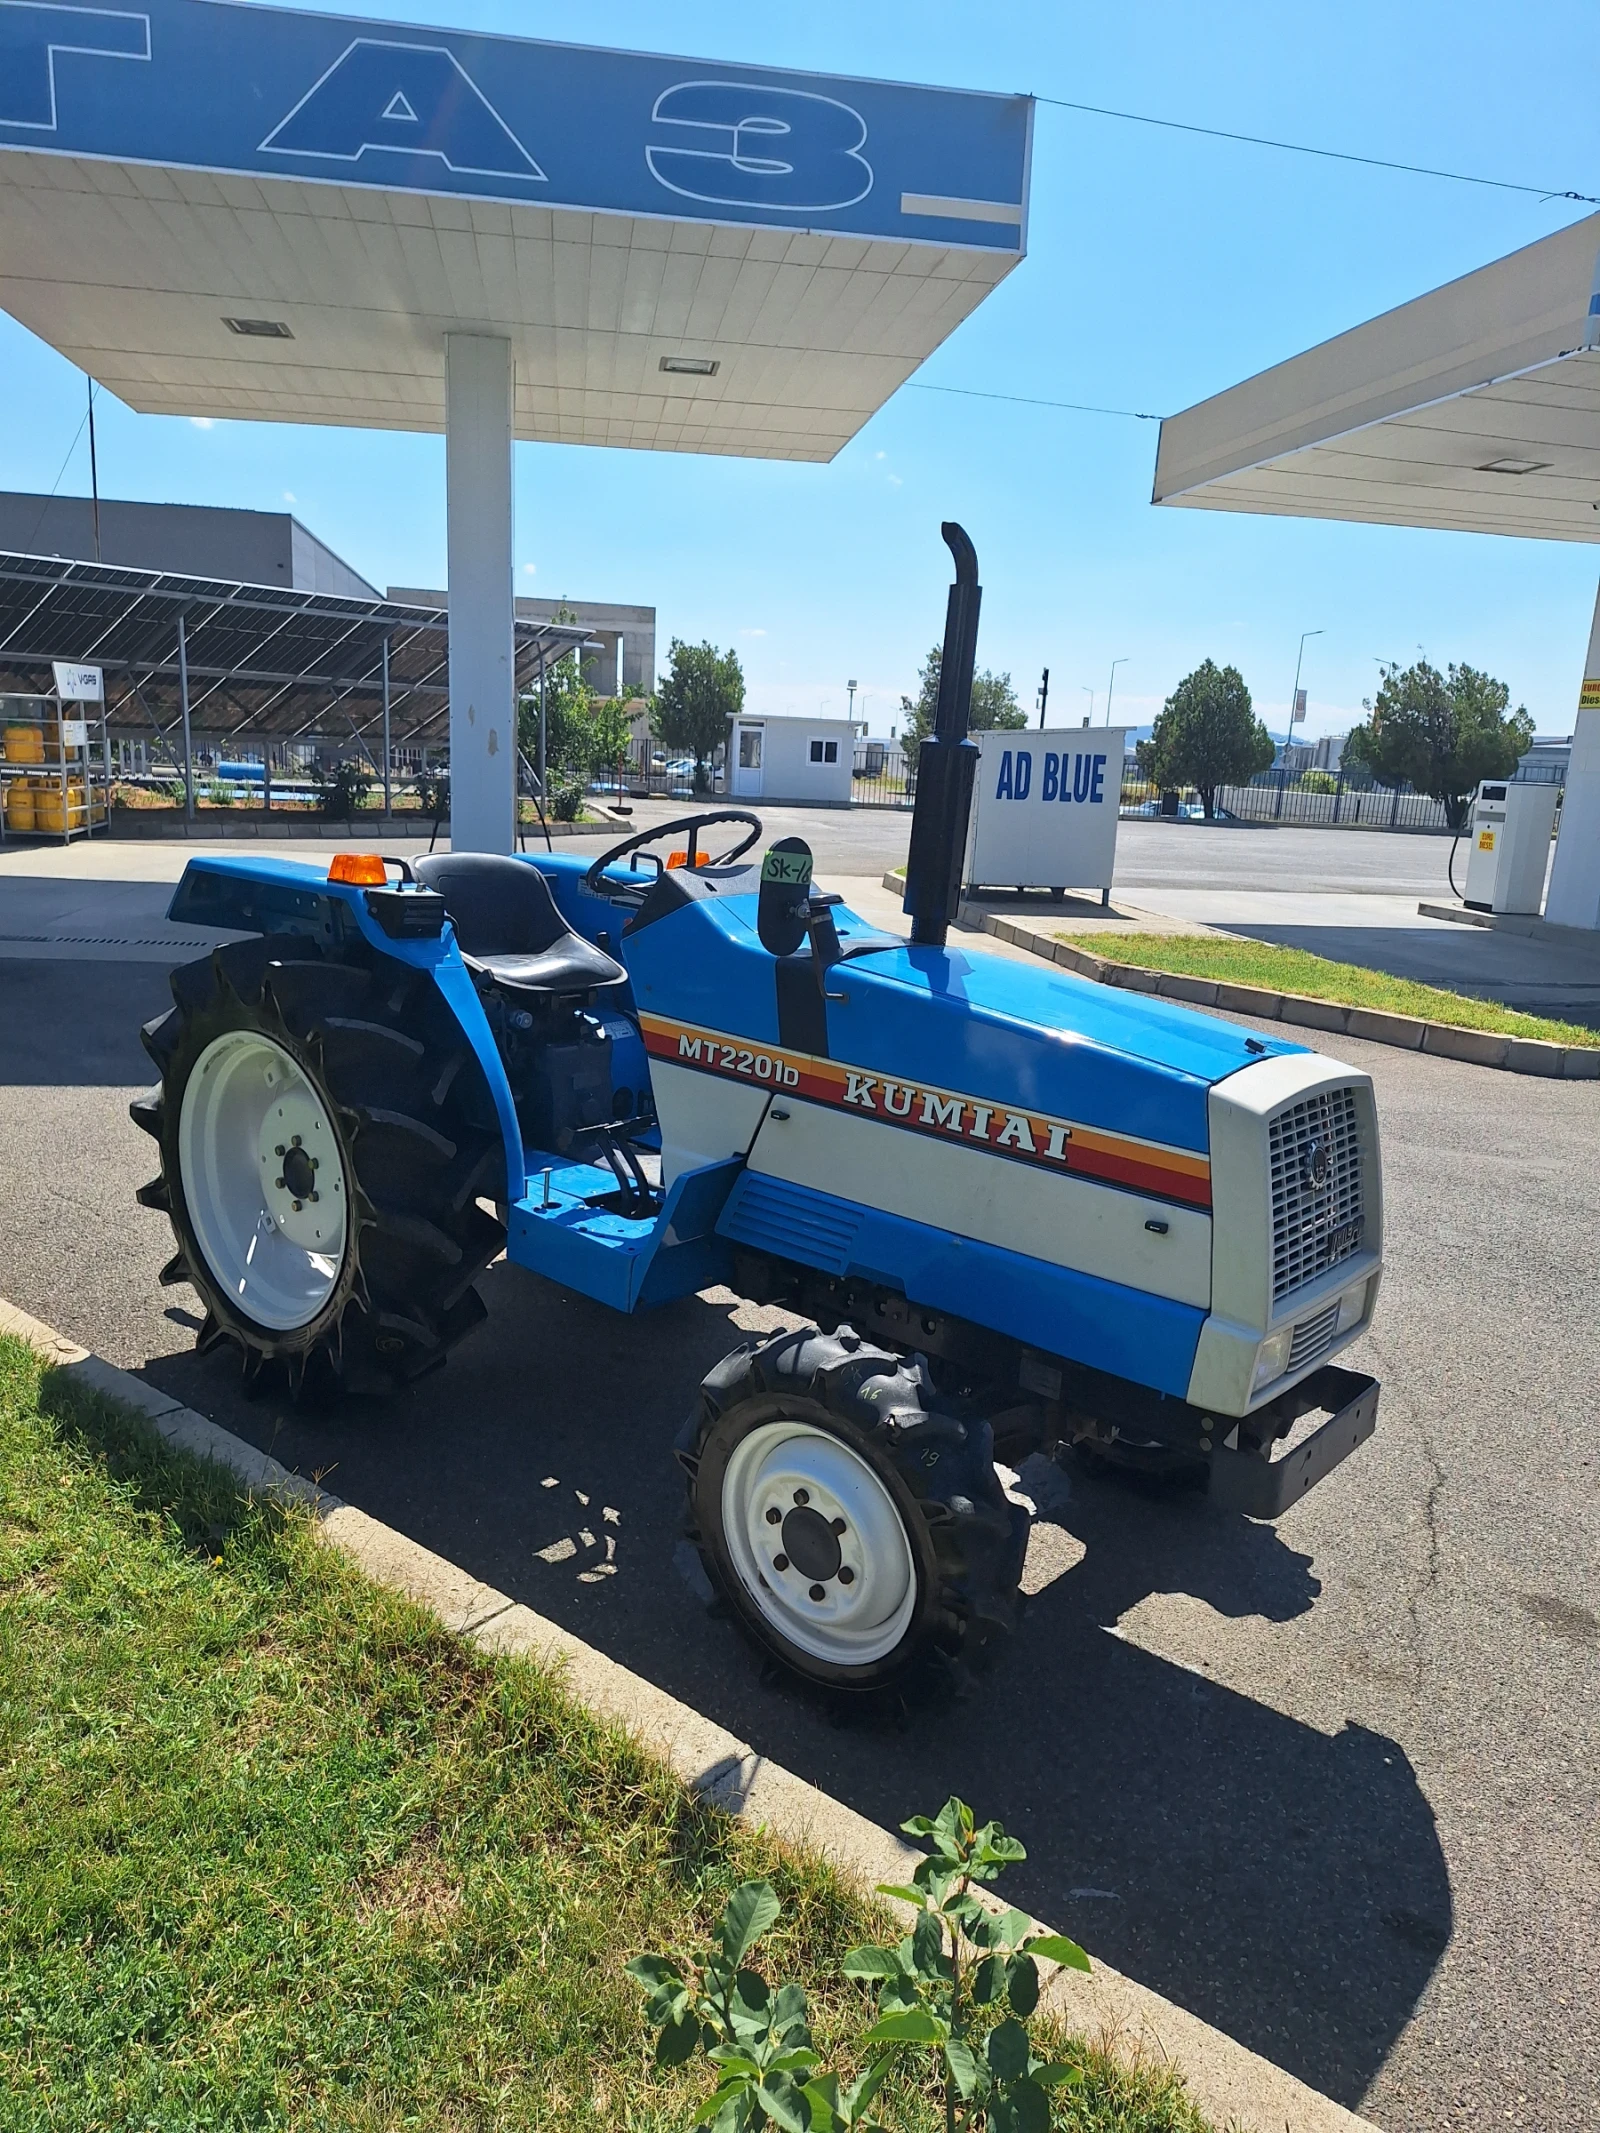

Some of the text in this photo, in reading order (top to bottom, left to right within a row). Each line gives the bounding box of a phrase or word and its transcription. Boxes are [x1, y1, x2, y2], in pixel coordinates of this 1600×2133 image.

[996, 751, 1107, 803] AD BLUE
[678, 1034, 799, 1087] MT2201D
[842, 1071, 1072, 1161] KUMIAI
